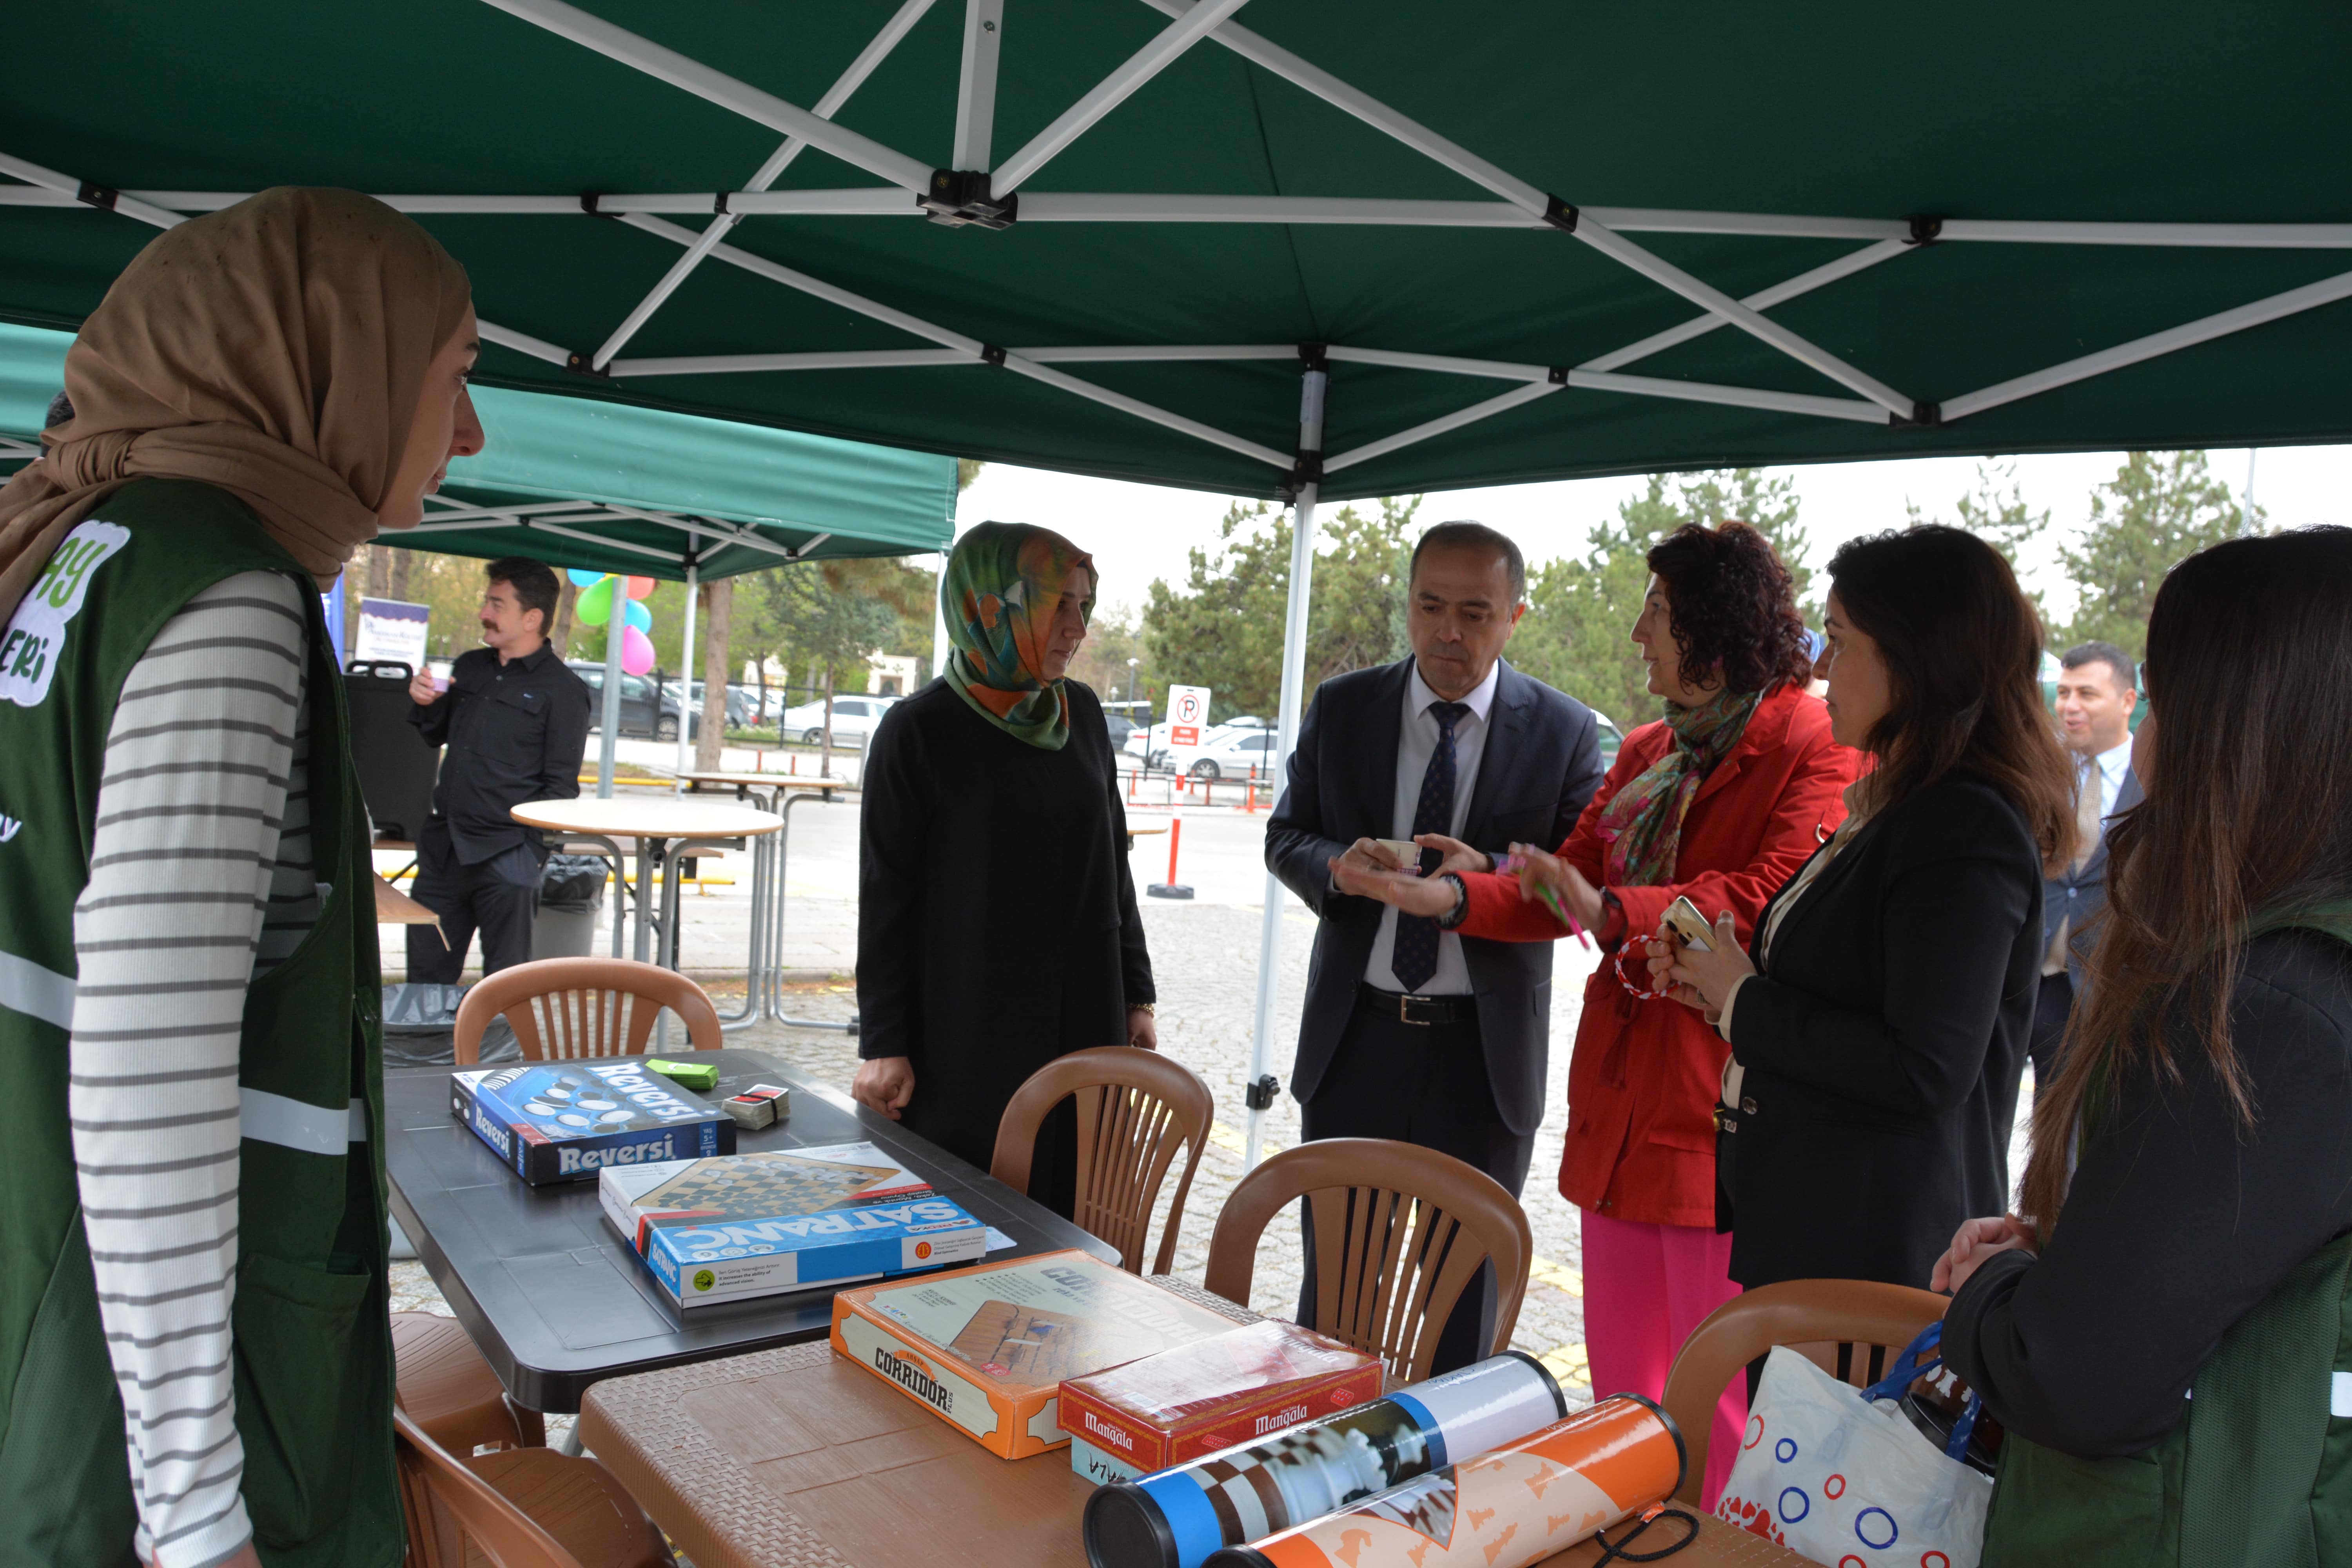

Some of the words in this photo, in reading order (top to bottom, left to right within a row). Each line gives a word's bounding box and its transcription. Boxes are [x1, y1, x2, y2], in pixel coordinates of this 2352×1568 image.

[587, 1062, 718, 1123] Reversi
[475, 1103, 510, 1158] Reversi
[558, 1133, 676, 1175] Reversi
[875, 1347, 948, 1412] CORRIDOR
[1085, 1411, 1132, 1451] Mangala
[1255, 1404, 1307, 1435] Mangala
